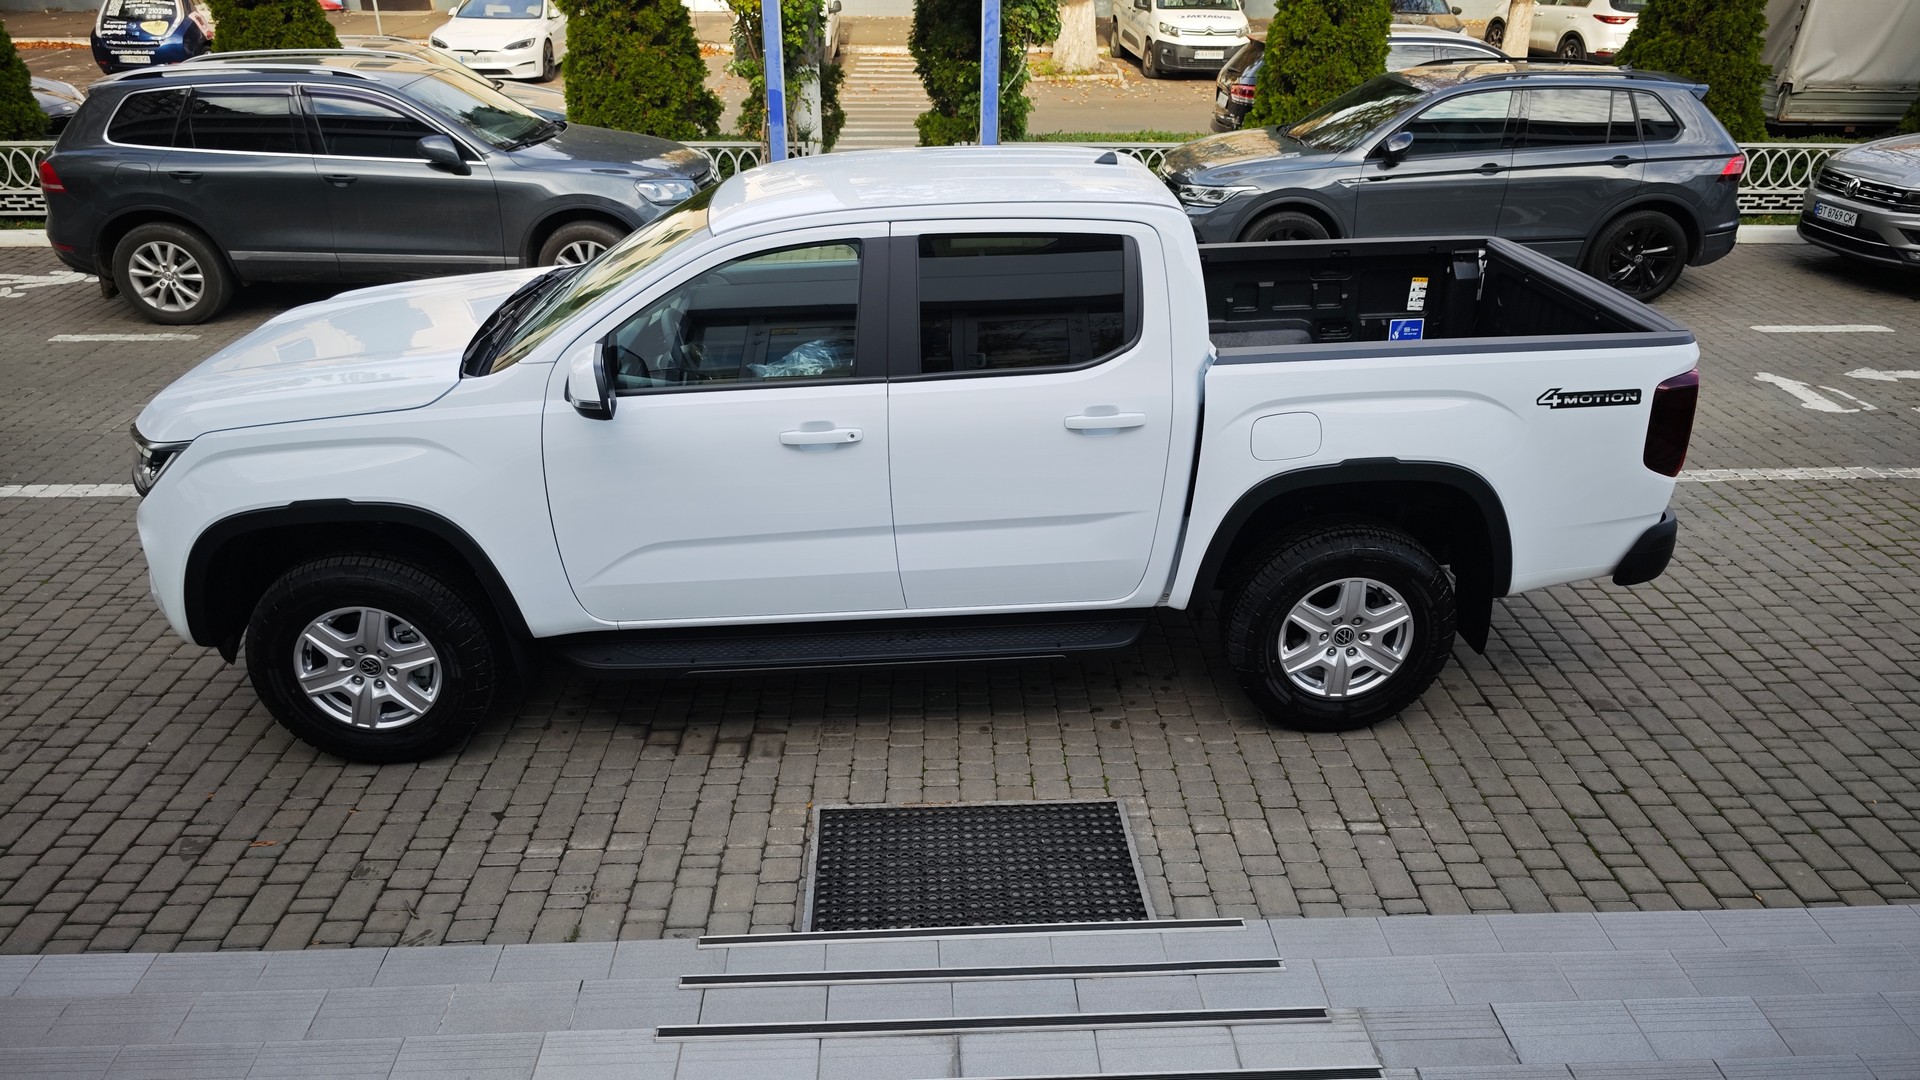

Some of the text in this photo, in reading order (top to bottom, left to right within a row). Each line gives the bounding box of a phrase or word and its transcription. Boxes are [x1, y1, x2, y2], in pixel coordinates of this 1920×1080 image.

[1818, 205, 1856, 224] BT 8769 CK
[1538, 388, 1638, 407] 4MOTION
